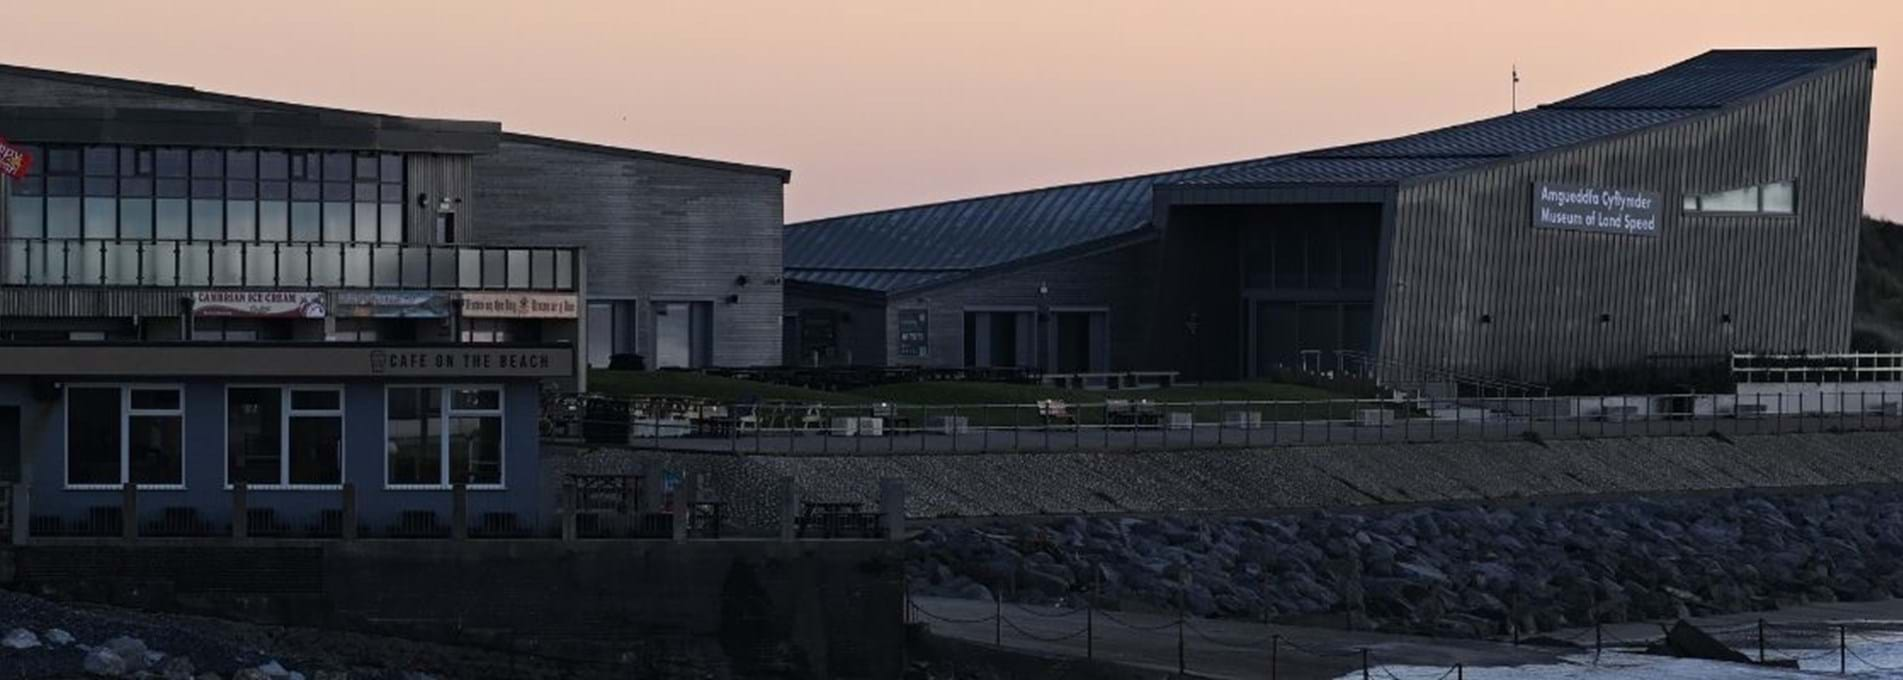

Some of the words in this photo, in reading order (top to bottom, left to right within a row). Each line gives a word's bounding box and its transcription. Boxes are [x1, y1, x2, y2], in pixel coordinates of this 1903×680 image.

[1541, 186, 1600, 206] Amgueddfa
[1602, 190, 1652, 211] Cyflymder
[1541, 207, 1583, 225] Museum
[1585, 210, 1597, 226] of
[1598, 212, 1622, 228] Land
[1624, 214, 1656, 233] Speed
[247, 293, 263, 302] ICE
[265, 293, 296, 302] CREAM
[390, 354, 426, 368] CAFE
[435, 354, 454, 368] ON
[463, 354, 491, 368] THE
[500, 354, 549, 369] BEACH
